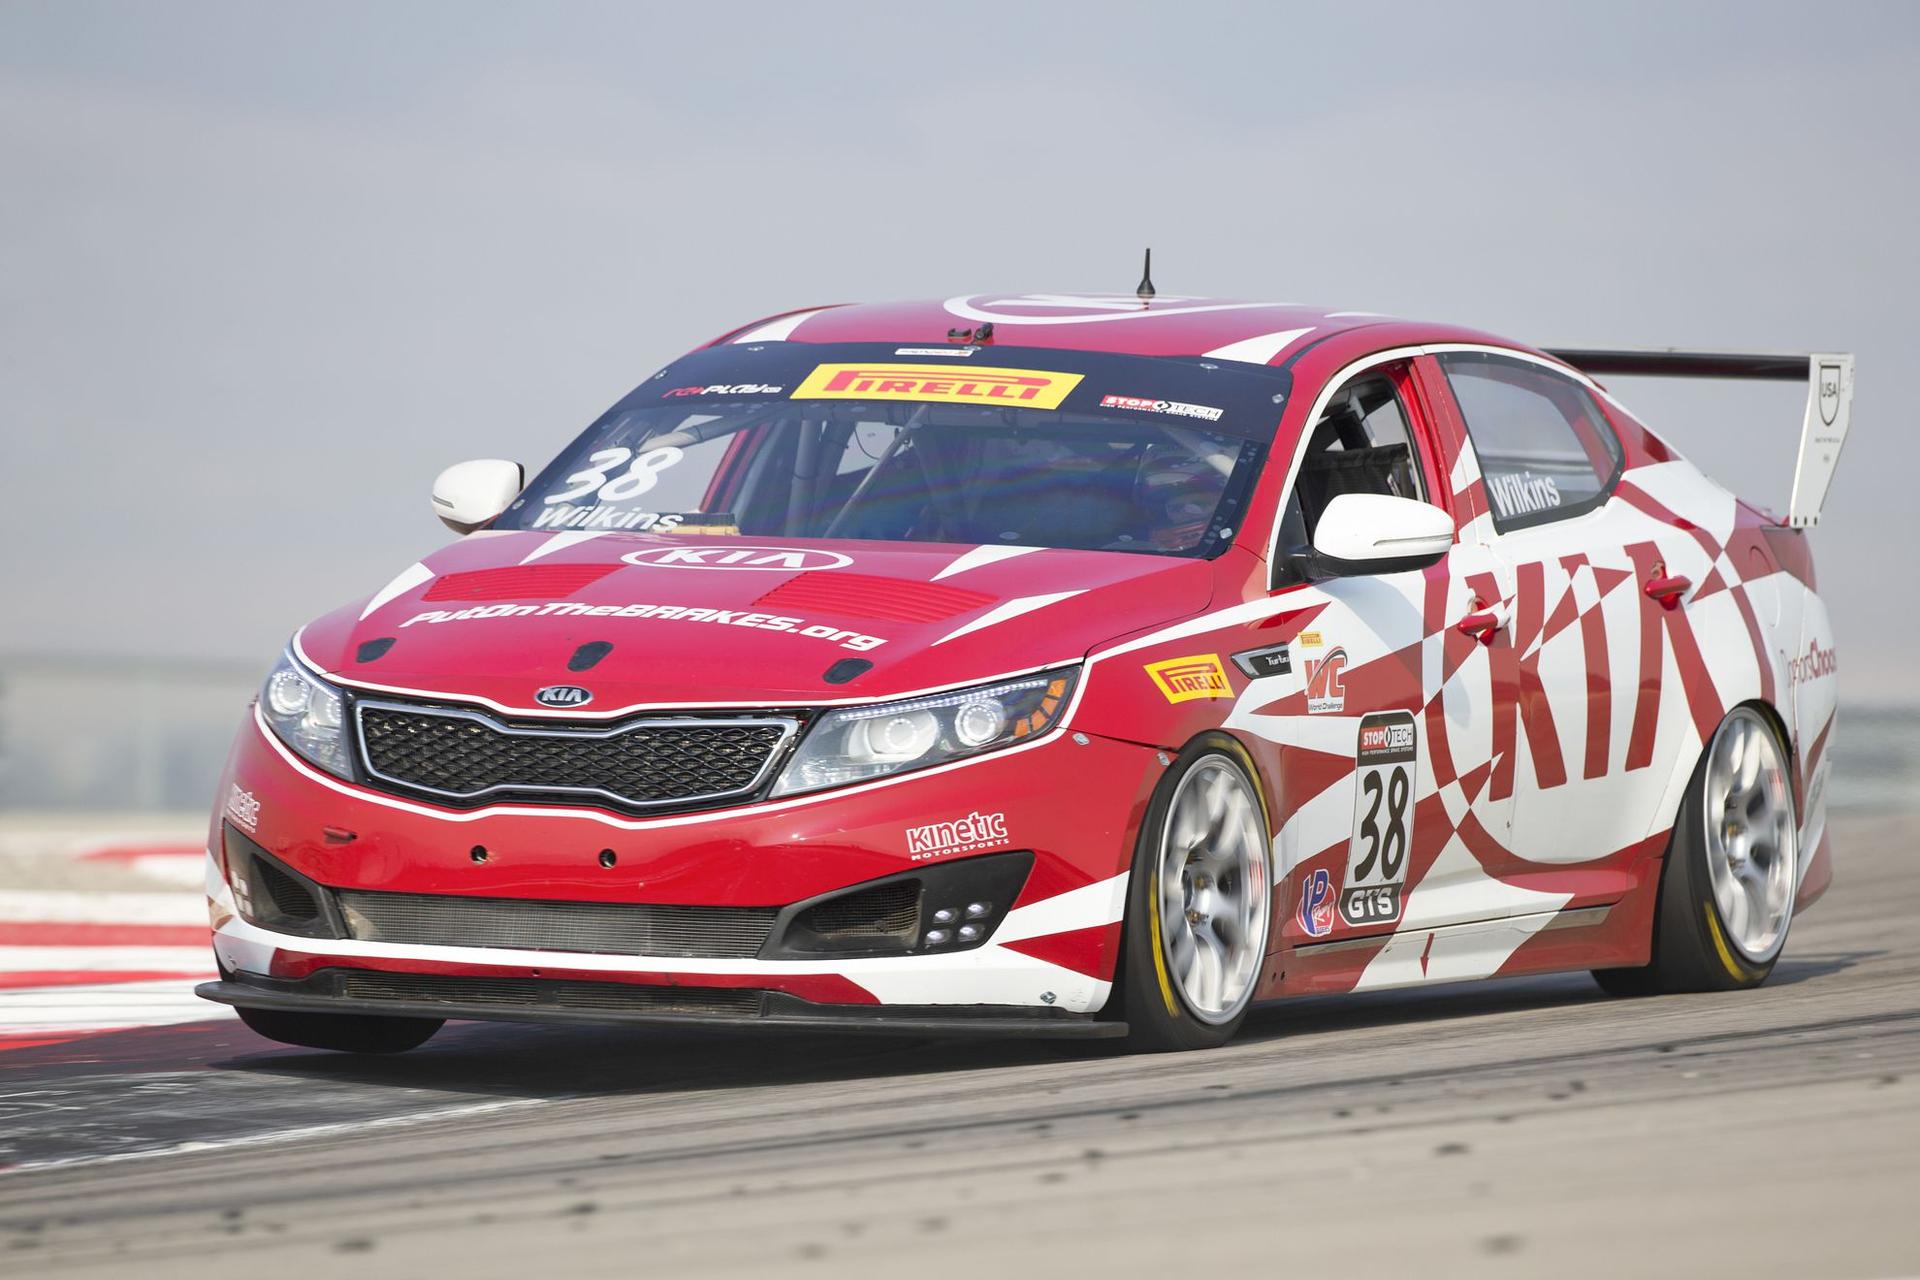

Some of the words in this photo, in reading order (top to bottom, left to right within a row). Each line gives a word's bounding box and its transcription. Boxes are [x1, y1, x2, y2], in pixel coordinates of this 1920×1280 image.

[823, 370, 1053, 401] PIRELLI
[1106, 396, 1153, 407] STOP
[1821, 382, 1838, 398] USA
[545, 447, 684, 505] 38
[1488, 471, 1561, 518] Wilkins
[532, 506, 684, 532] Wilkins
[654, 549, 806, 567] KIA
[399, 602, 888, 651] PutOnTheBRAKES.org
[1158, 662, 1226, 694] PIRELLI
[1304, 657, 1344, 700] WC
[1464, 541, 1727, 802] KIA
[539, 687, 586, 704] KIA
[1363, 731, 1384, 746] STOP
[1392, 728, 1412, 742] TECH
[905, 811, 1008, 853] Kinetic
[1354, 765, 1409, 882] 38
[911, 838, 1010, 860] MOTORSPORTS
[1347, 887, 1394, 919] GTS
